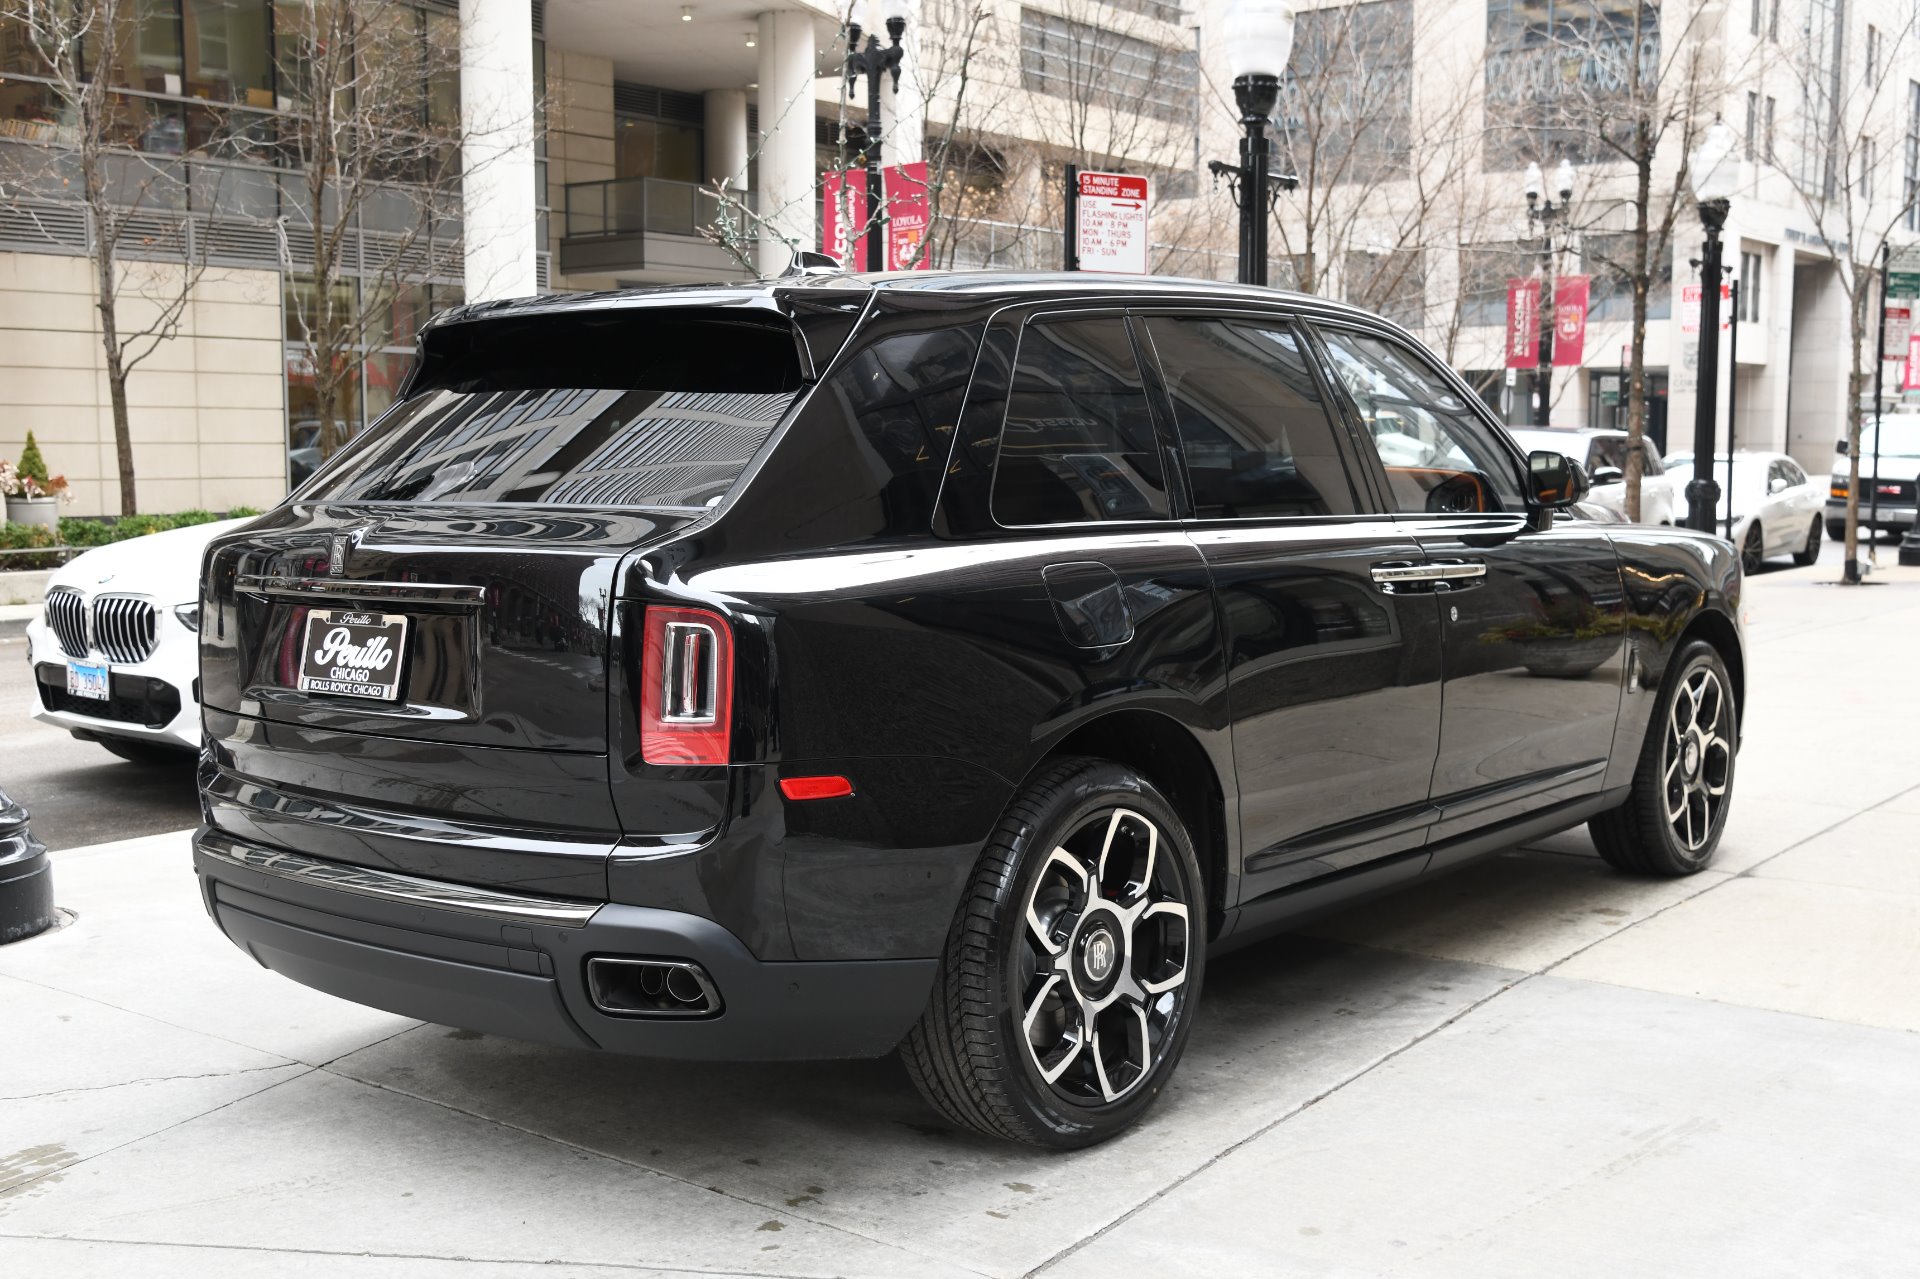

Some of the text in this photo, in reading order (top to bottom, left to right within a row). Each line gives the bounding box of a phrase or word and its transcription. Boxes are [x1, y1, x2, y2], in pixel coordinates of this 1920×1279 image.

[1083, 175, 1119, 187] 15 MINUTE
[1082, 185, 1141, 198] STANDING ZONE
[1082, 200, 1097, 209] USE
[892, 215, 923, 228] LOYOLA
[1082, 210, 1144, 222] FLASHING LIGHTS
[1117, 221, 1128, 229] PM
[1107, 229, 1132, 239] THURS
[1082, 246, 1094, 254] FRI
[1101, 248, 1117, 256] SUN
[340, 612, 371, 625] Perillo
[314, 627, 393, 670] Perillo
[330, 666, 370, 682] CHICAGO
[310, 680, 382, 696] ROLLS ROYCE CHICAGO
